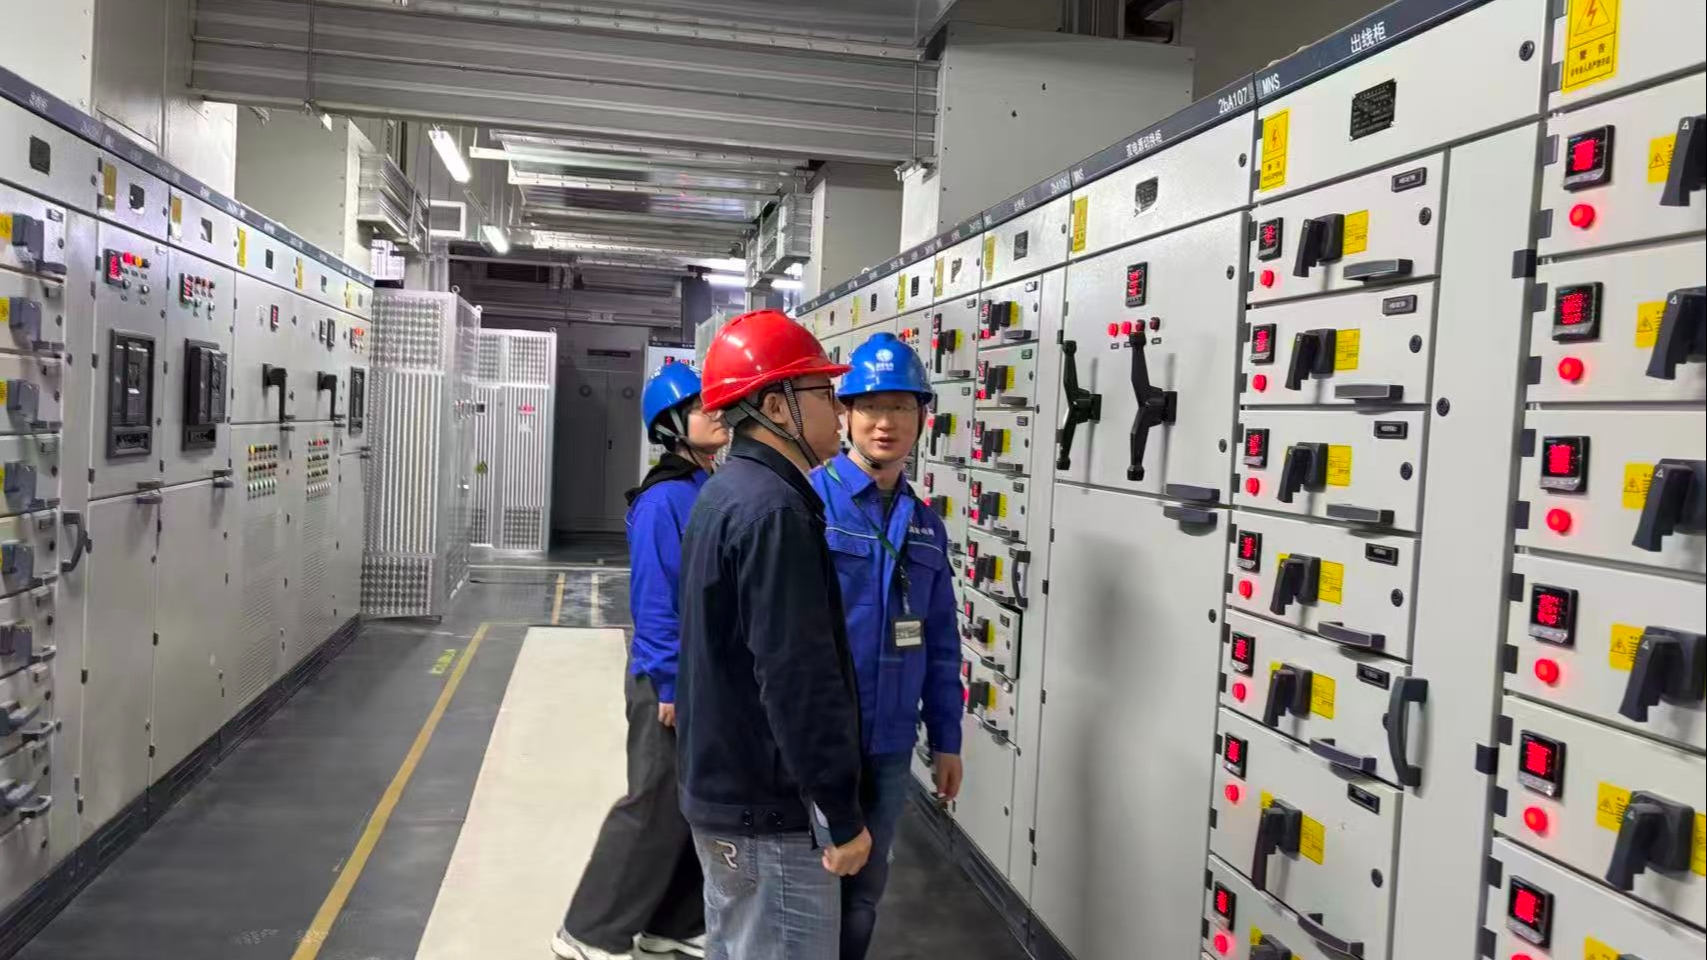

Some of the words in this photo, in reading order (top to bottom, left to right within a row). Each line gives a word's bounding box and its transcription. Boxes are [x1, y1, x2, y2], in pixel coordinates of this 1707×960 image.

[1351, 21, 1387, 53] 出线柜
[1262, 73, 1281, 97] MNS
